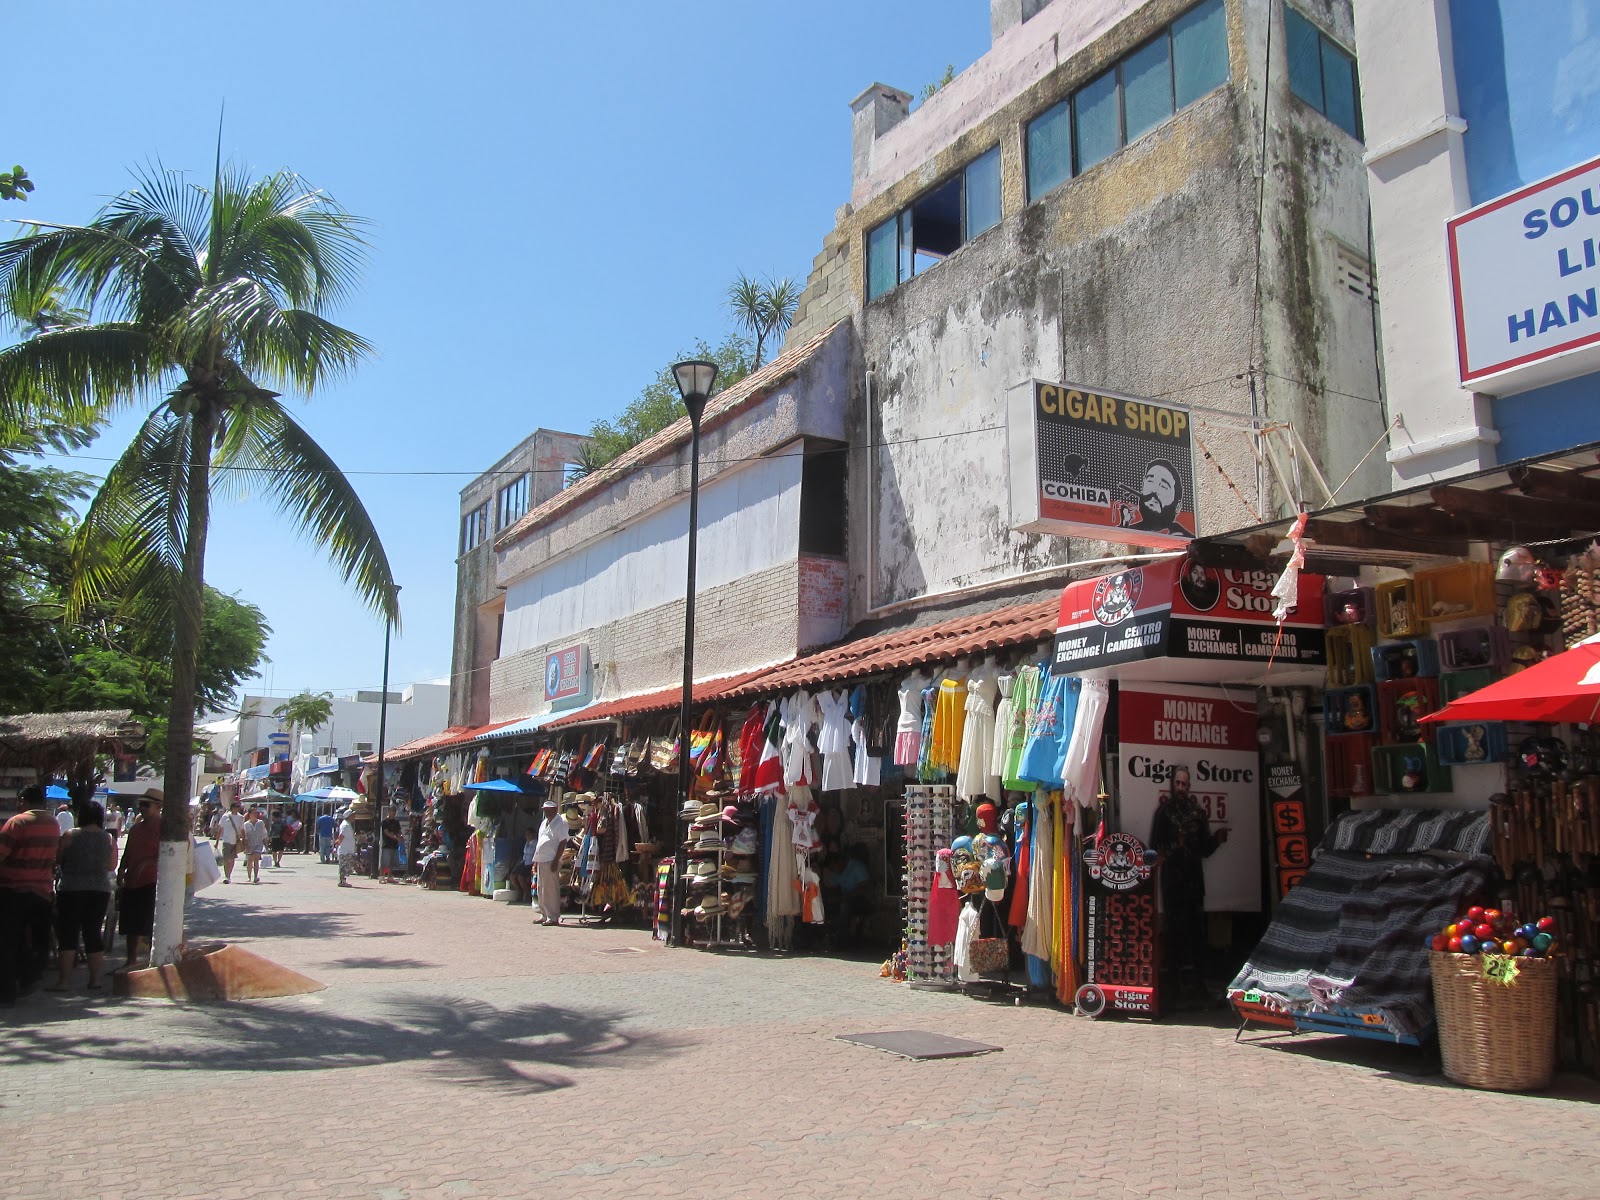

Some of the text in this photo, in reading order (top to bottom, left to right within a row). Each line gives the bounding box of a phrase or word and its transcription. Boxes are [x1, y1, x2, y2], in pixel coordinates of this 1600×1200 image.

[1557, 238, 1600, 278] LI
[1040, 384, 1187, 438] CIGAR SHOP
[1044, 482, 1109, 505] COHIBA
[1095, 599, 1135, 624] DOLLAR
[1125, 620, 1162, 639] CENTRO
[1187, 626, 1221, 641] MONEY
[1260, 632, 1297, 645] CENTRO
[1057, 636, 1088, 653] MONEY
[1106, 632, 1161, 653] CAMBIARIO
[1188, 640, 1238, 655] EXCHANGE
[1244, 643, 1298, 658] CAMBIARIO
[1056, 645, 1101, 663] EXCHANGE
[1163, 699, 1214, 722] MONEY
[1153, 720, 1228, 745] EXCHANGE
[1128, 755, 1253, 784] Ciga Store
[1271, 765, 1294, 777] MONEY
[1268, 775, 1301, 788] EXCHANGE
[1098, 833, 1143, 856] PANCHO
[1101, 865, 1140, 881] DOLLAR
[1105, 894, 1153, 917] 16.25
[1088, 916, 1096, 938] DOLLAR
[1105, 916, 1153, 940] 12.35
[1104, 938, 1153, 963] 12.30
[1095, 960, 1153, 986] 20.00
[1487, 960, 1499, 977] 2
[1114, 989, 1150, 1001] Cigar
[1114, 1000, 1150, 1010] Store
